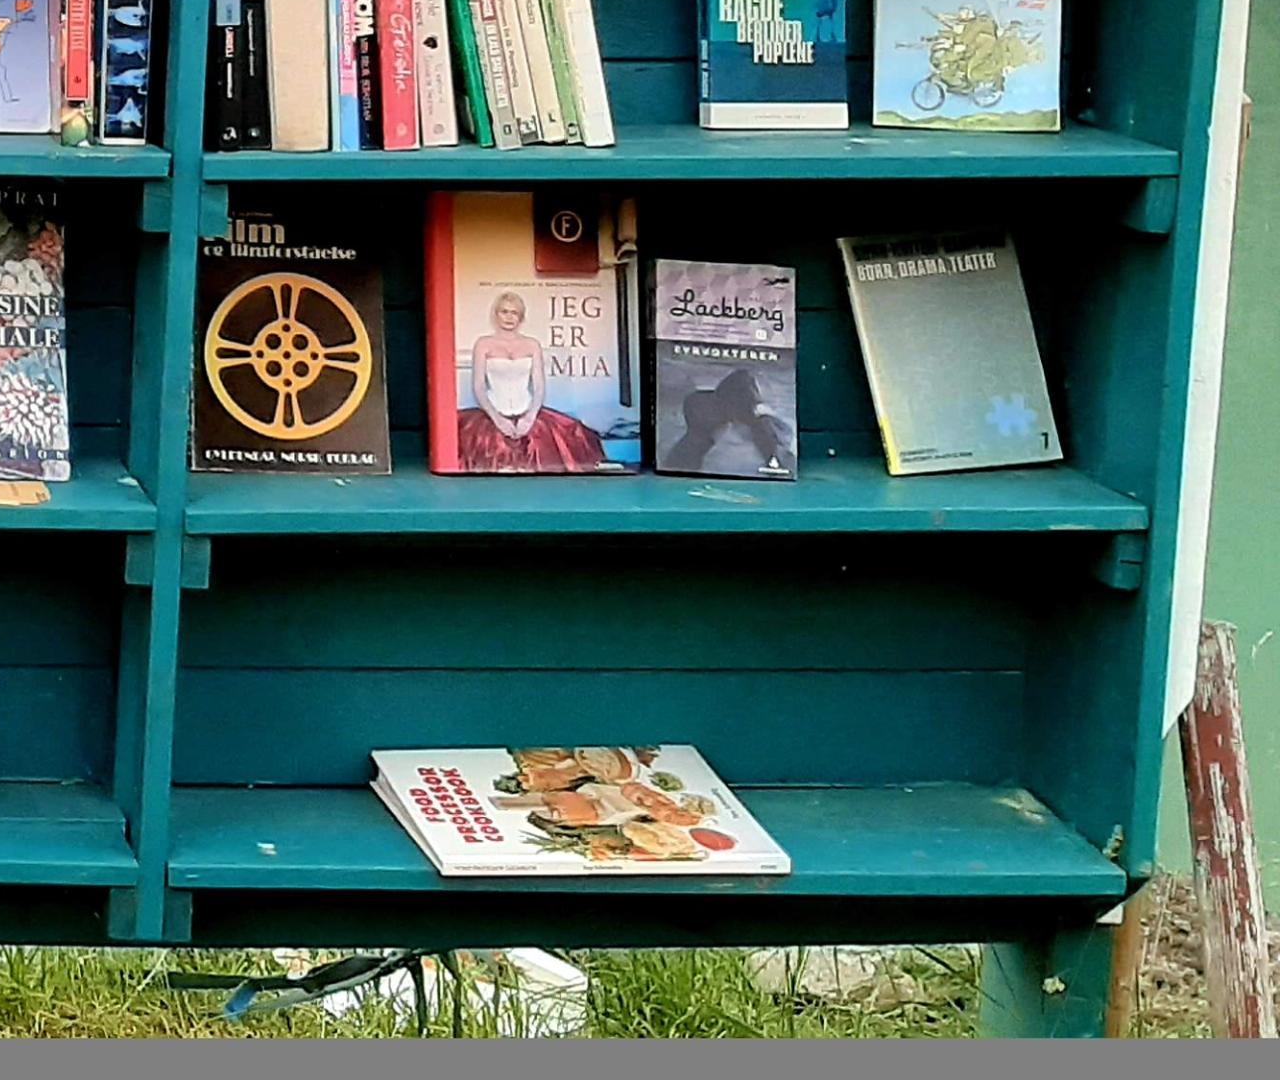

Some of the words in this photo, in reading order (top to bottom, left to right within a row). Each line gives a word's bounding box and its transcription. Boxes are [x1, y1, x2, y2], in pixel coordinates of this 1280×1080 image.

[549, 294, 603, 320] JEG
[549, 324, 589, 349] ER
[548, 355, 611, 378] MIA
[409, 787, 446, 823] FOOD
[417, 767, 484, 843] PROCESSOR
[439, 767, 504, 842] COOKBOOK
